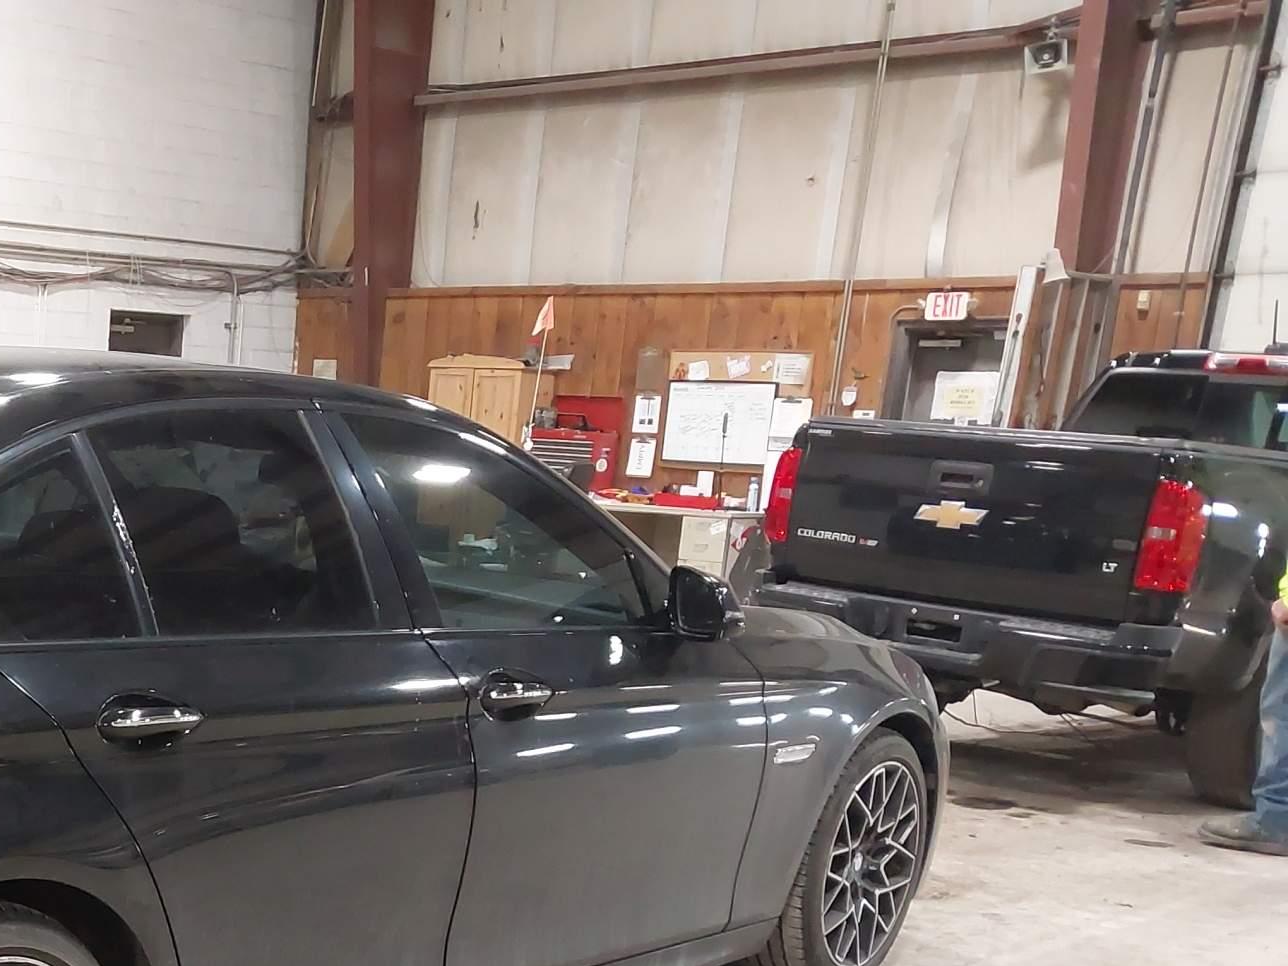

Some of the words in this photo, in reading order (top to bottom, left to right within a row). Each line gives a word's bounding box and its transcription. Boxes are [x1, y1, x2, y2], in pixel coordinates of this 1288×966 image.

[933, 294, 963, 318] EXIT
[797, 528, 857, 543] COLORADO
[1102, 562, 1118, 573] LT
